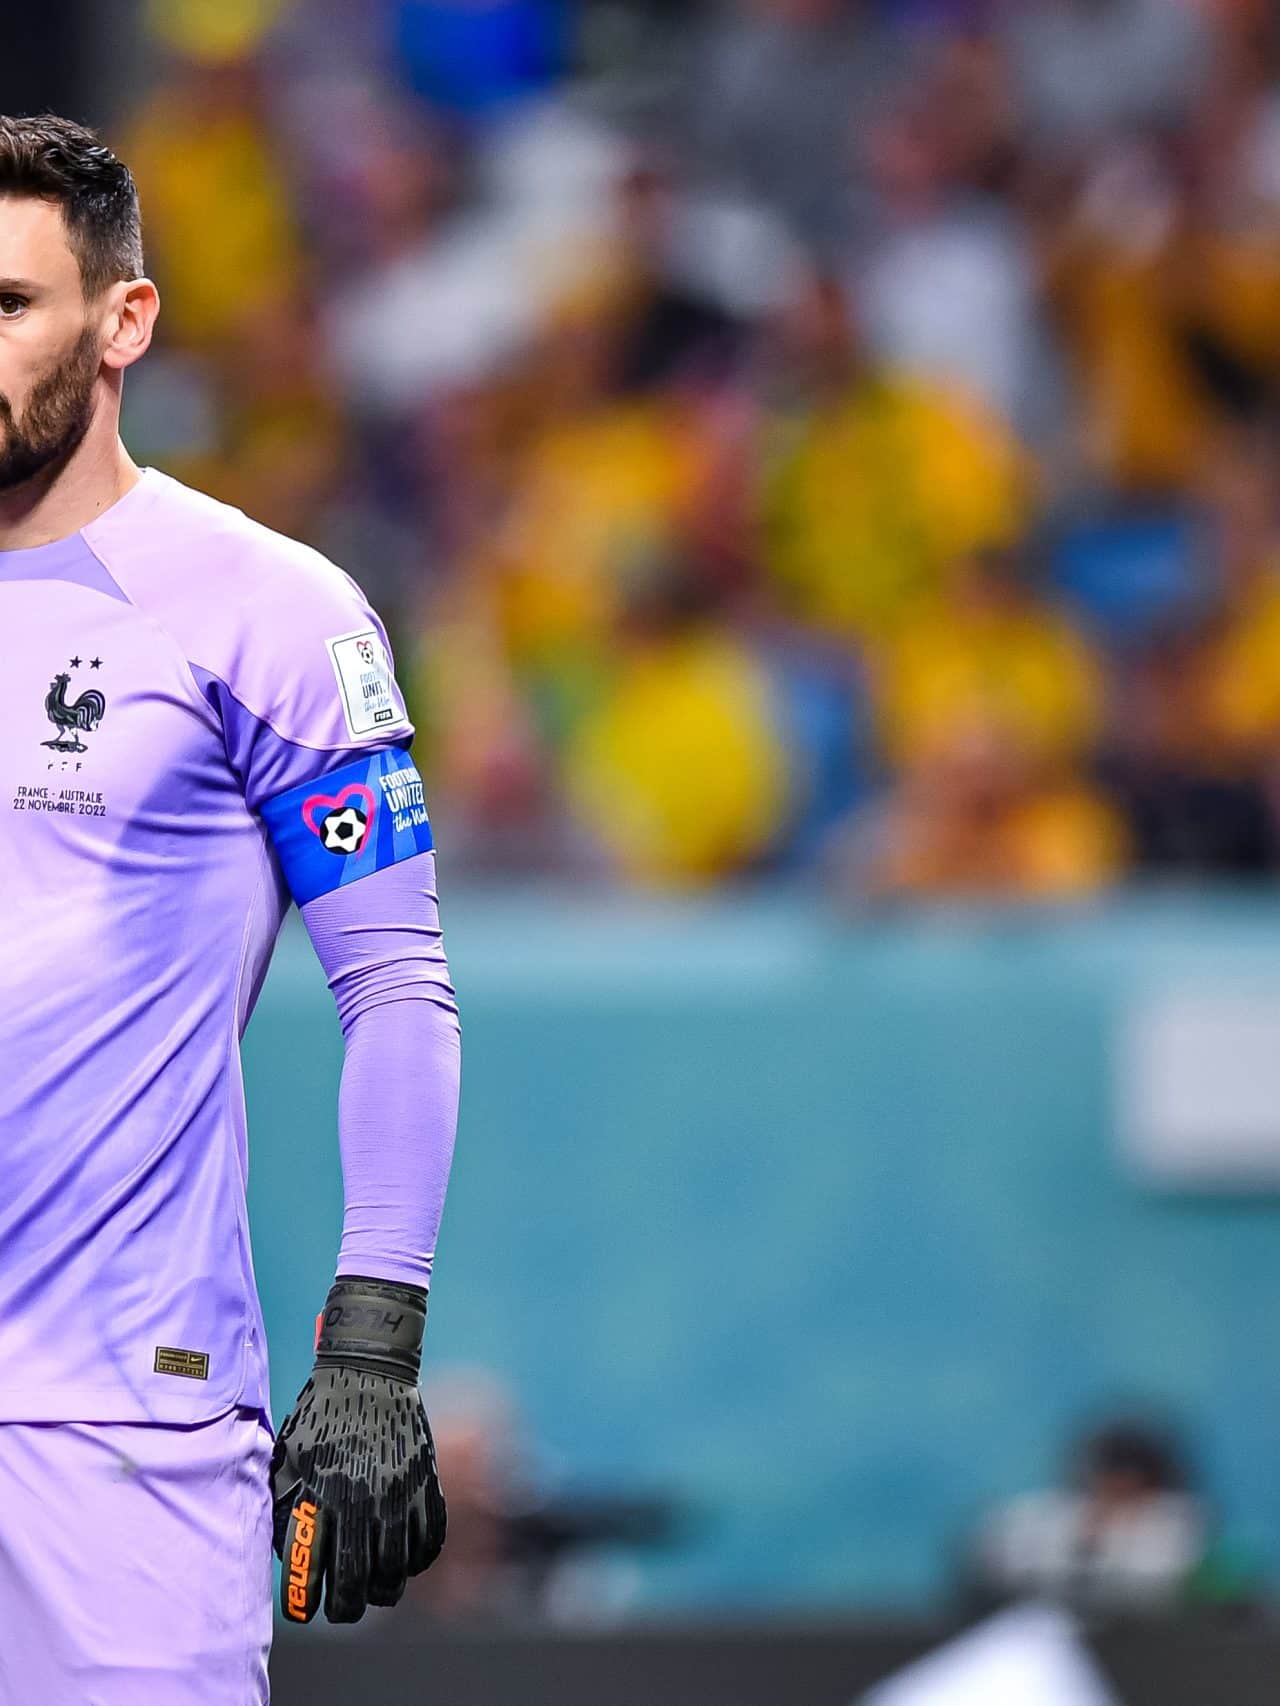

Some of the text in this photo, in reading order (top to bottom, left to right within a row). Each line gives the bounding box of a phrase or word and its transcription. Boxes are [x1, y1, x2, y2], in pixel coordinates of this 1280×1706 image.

[17, 786, 48, 799] FRANCE
[59, 790, 103, 804] AUSTRALIE
[13, 798, 106, 817] 22 NOVEMBRE 2022
[288, 1500, 317, 1620] reusch
